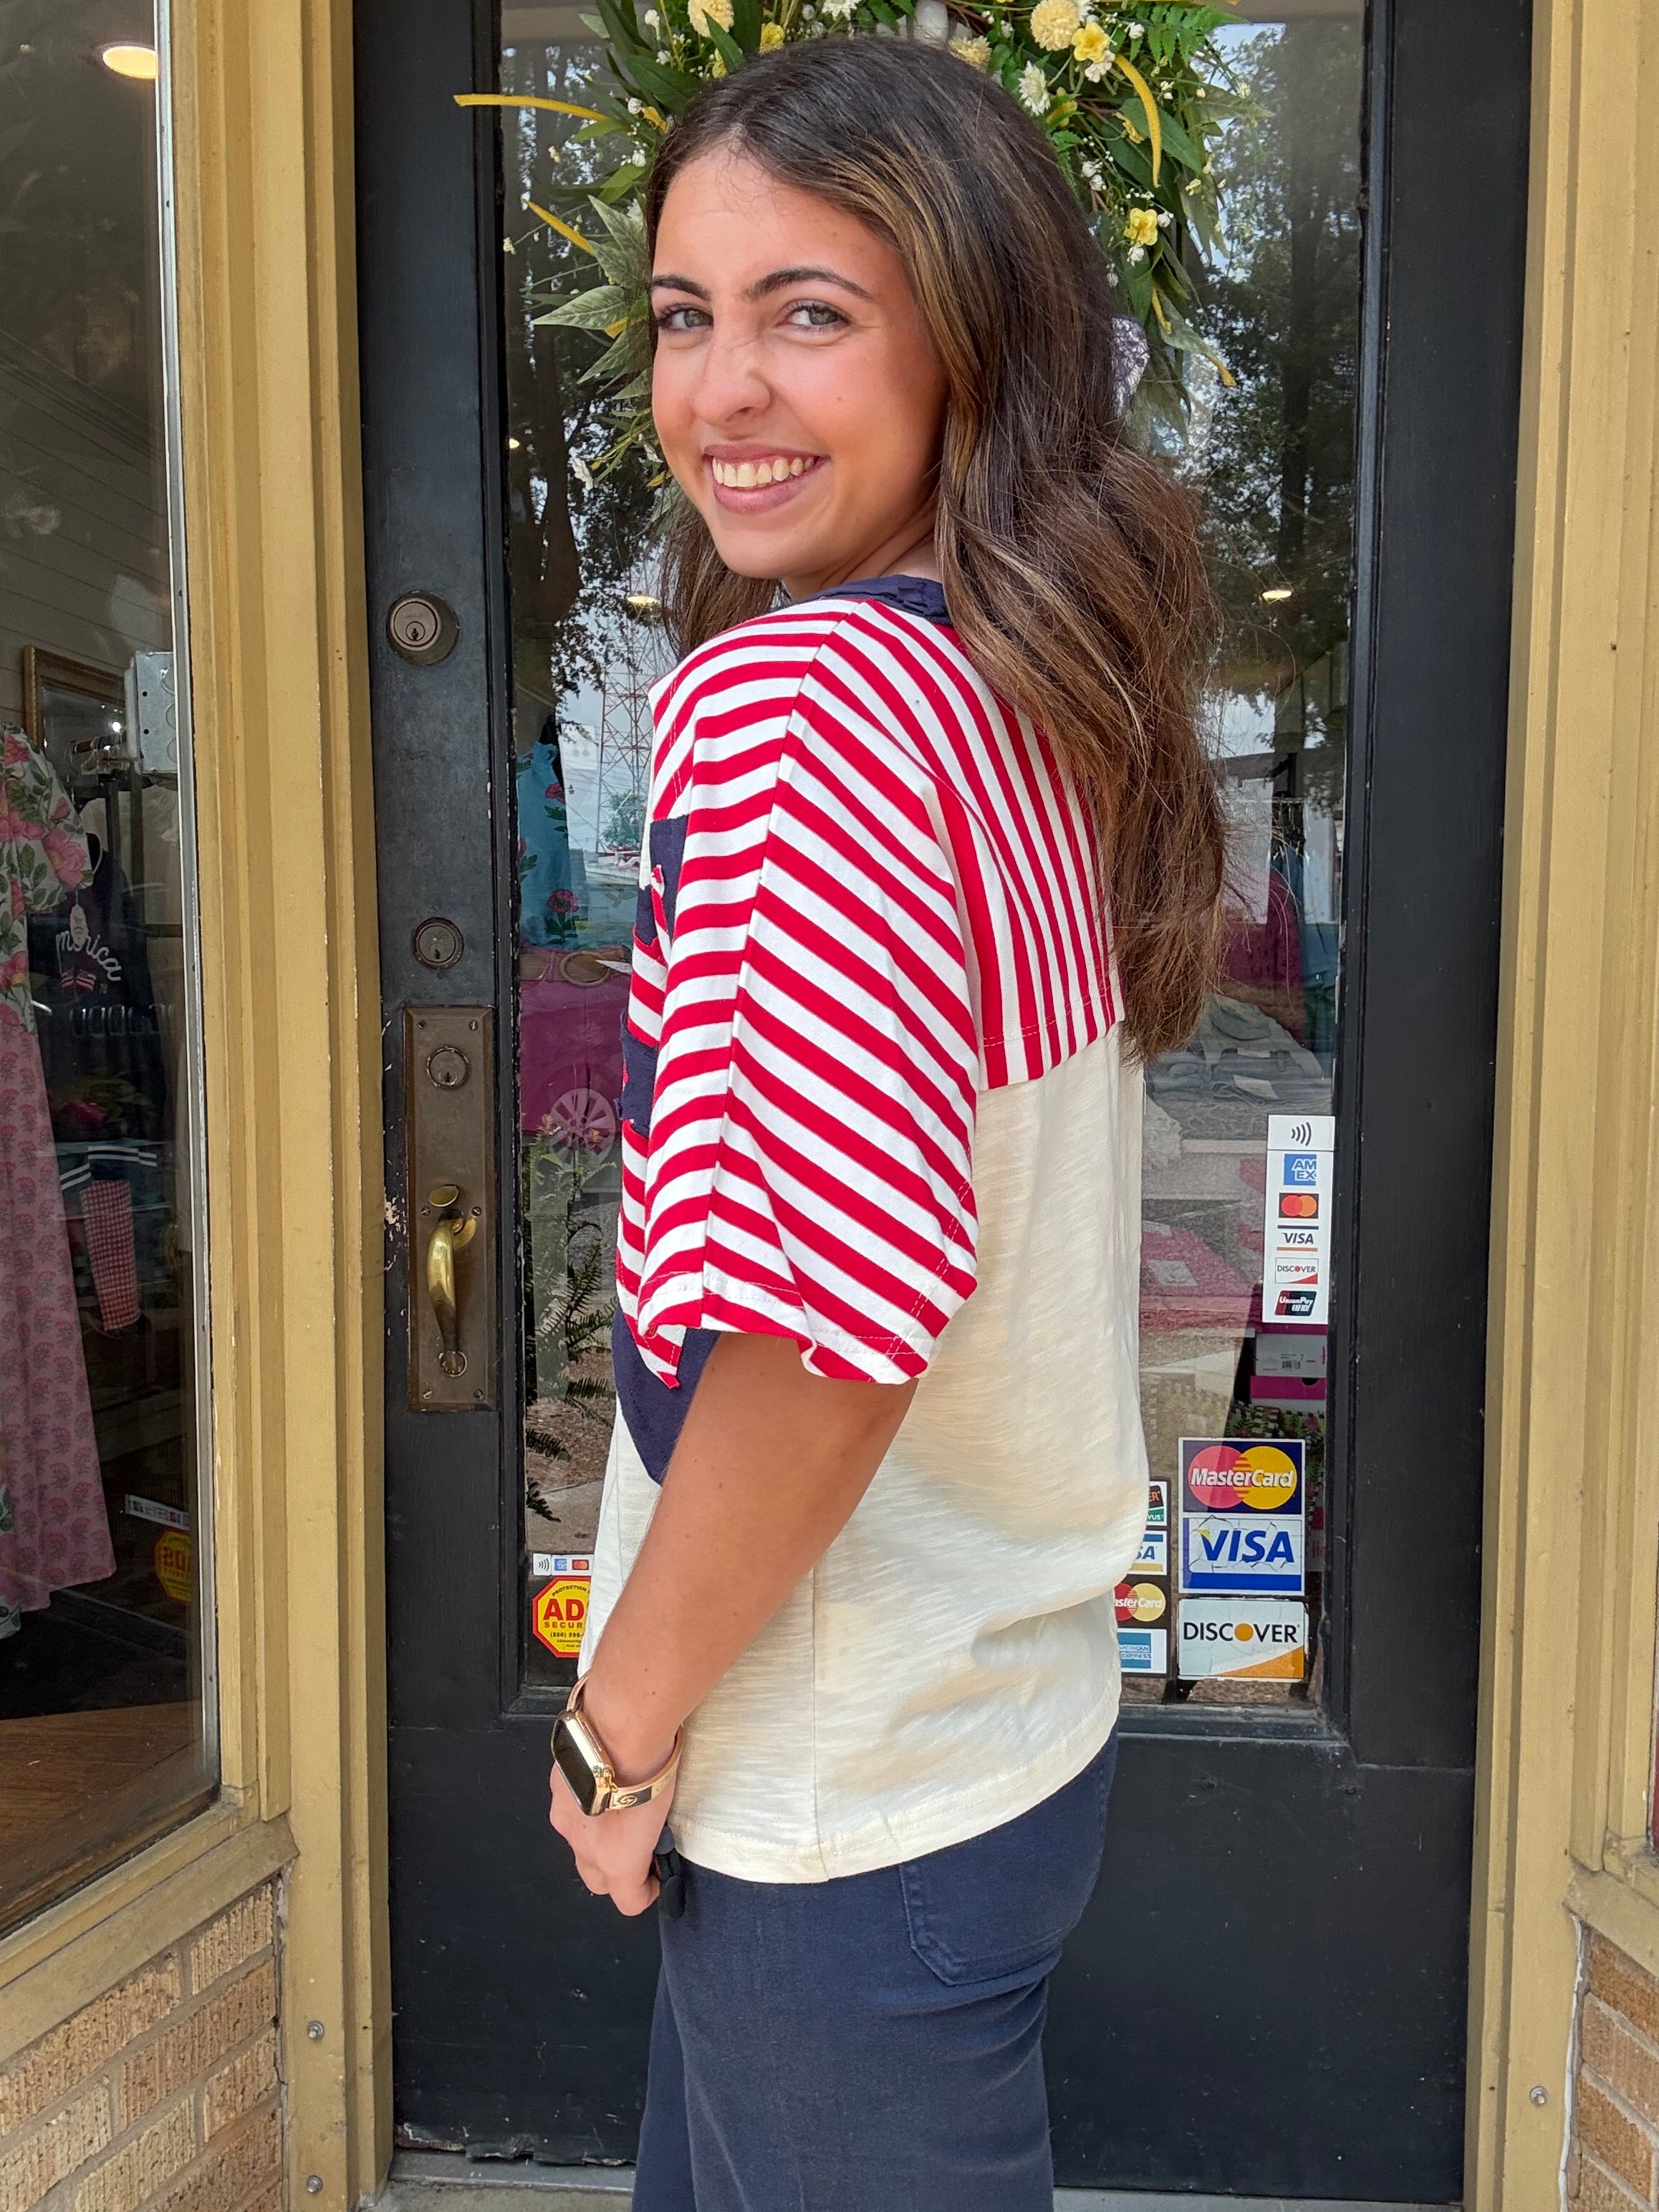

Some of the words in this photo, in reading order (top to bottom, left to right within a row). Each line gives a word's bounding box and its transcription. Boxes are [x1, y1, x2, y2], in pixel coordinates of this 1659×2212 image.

[1293, 1159, 1317, 1170] AM
[1296, 1170, 1316, 1180] EX
[1282, 1232, 1314, 1244] VISA
[1191, 1468, 1294, 1488] MasterCard
[1200, 1529, 1294, 1563] VISA
[543, 1599, 585, 1620] AD
[1115, 1597, 1163, 1608] asterCard
[1183, 1622, 1297, 1643] DISCOVER
